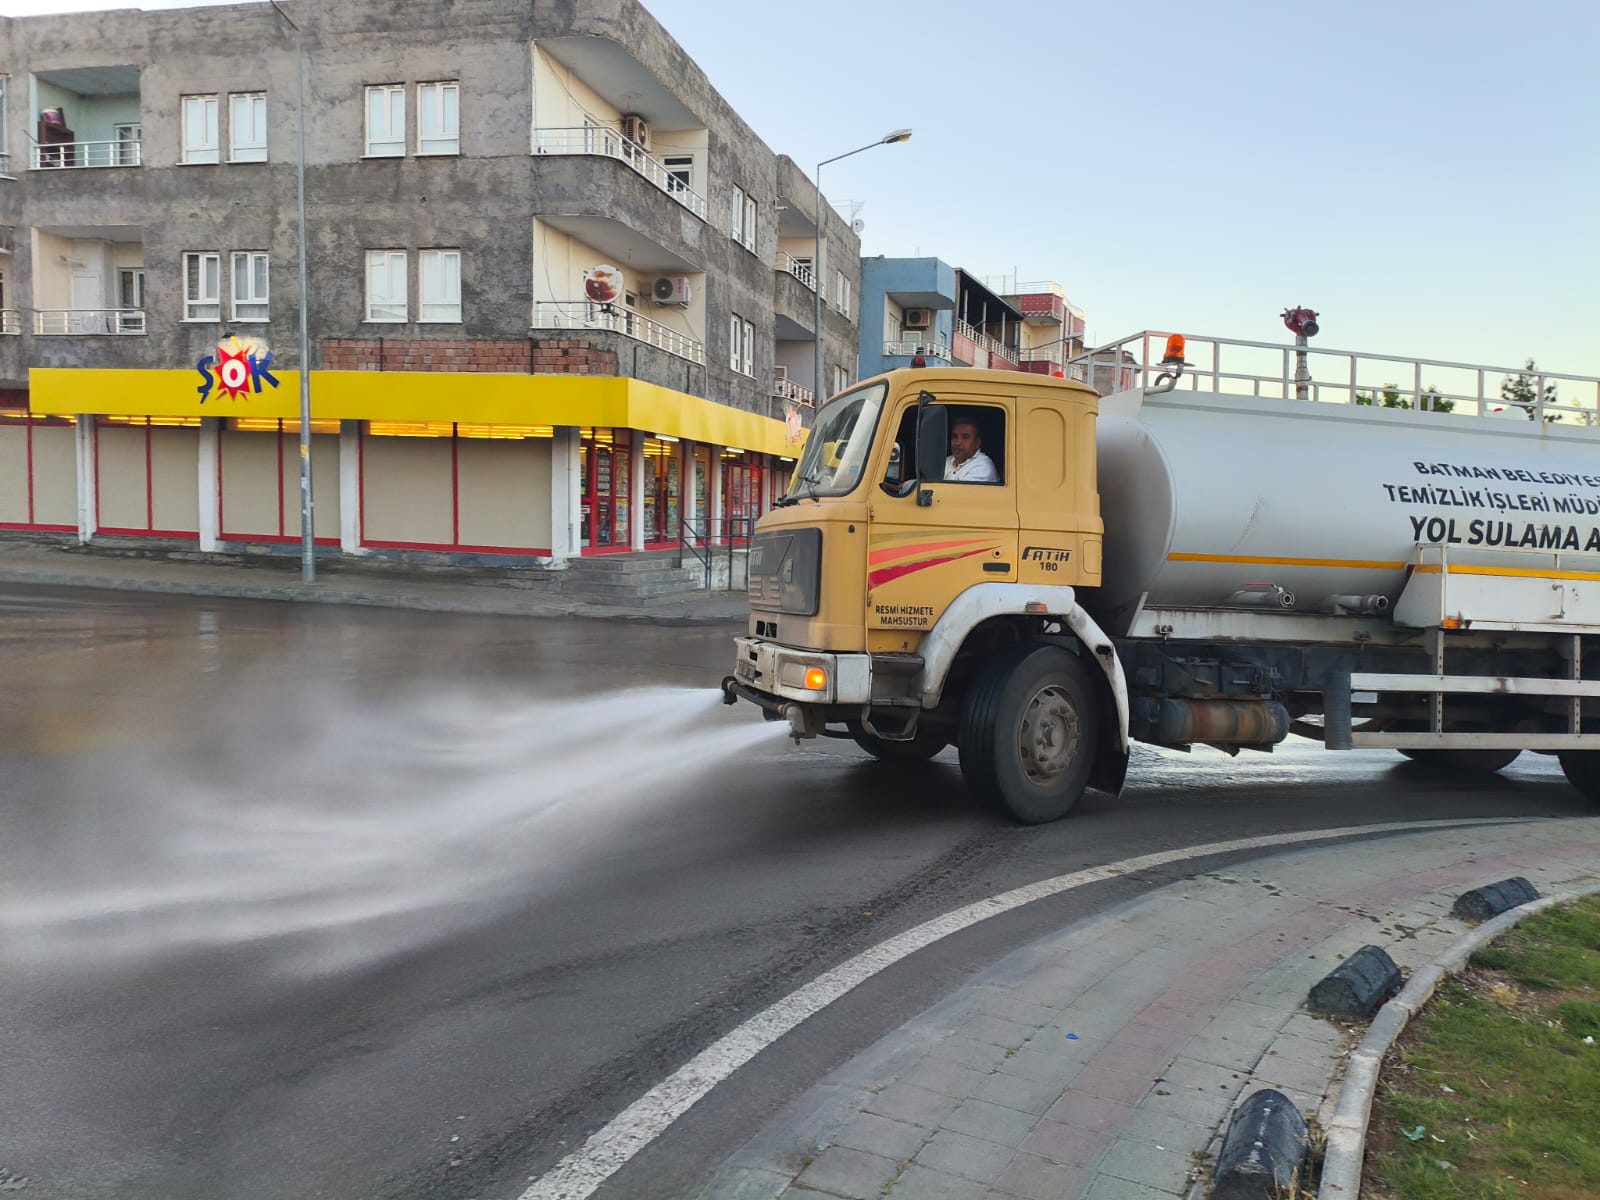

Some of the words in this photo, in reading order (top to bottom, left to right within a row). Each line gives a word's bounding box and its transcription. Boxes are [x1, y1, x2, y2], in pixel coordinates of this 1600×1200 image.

[197, 348, 280, 404] ŞOK
[1413, 461, 1501, 480] BATMAN
[1383, 483, 1485, 508] TEMİZLİK
[1485, 488, 1550, 514] İŞLERİ
[1552, 493, 1600, 515] MÜD
[1409, 515, 1462, 543] YOL
[1467, 519, 1580, 550] SULAMA
[1040, 562, 1058, 571] 180
[875, 605, 899, 615] RESMİ
[900, 605, 934, 616] HİZMETE
[880, 616, 928, 626] MAHSUSTUR
